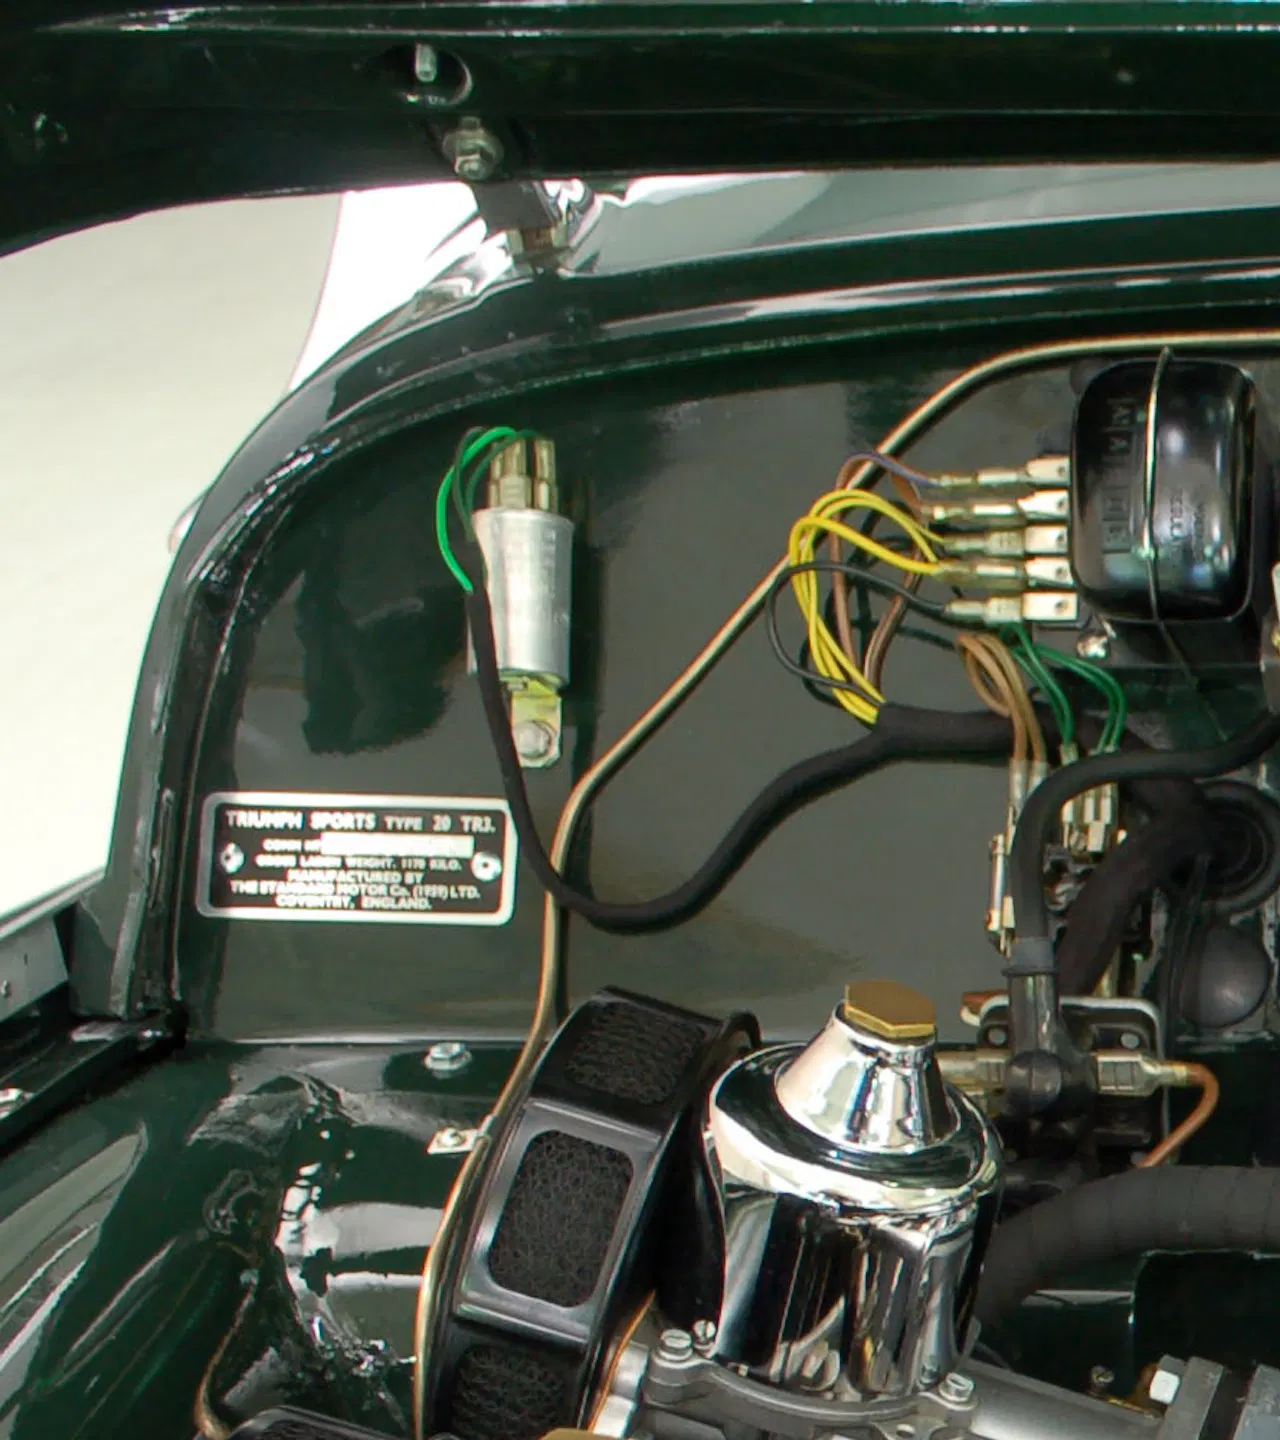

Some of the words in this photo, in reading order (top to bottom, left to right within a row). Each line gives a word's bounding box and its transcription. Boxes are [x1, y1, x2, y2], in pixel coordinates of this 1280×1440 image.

[226, 809, 303, 829] TRIUMPH
[310, 810, 376, 831] SPORTS
[384, 814, 423, 831] TYPE
[286, 868, 402, 884] MANUFACTURED
[404, 871, 425, 885] BY
[230, 879, 259, 894] THE
[336, 882, 388, 897] MOTOR
